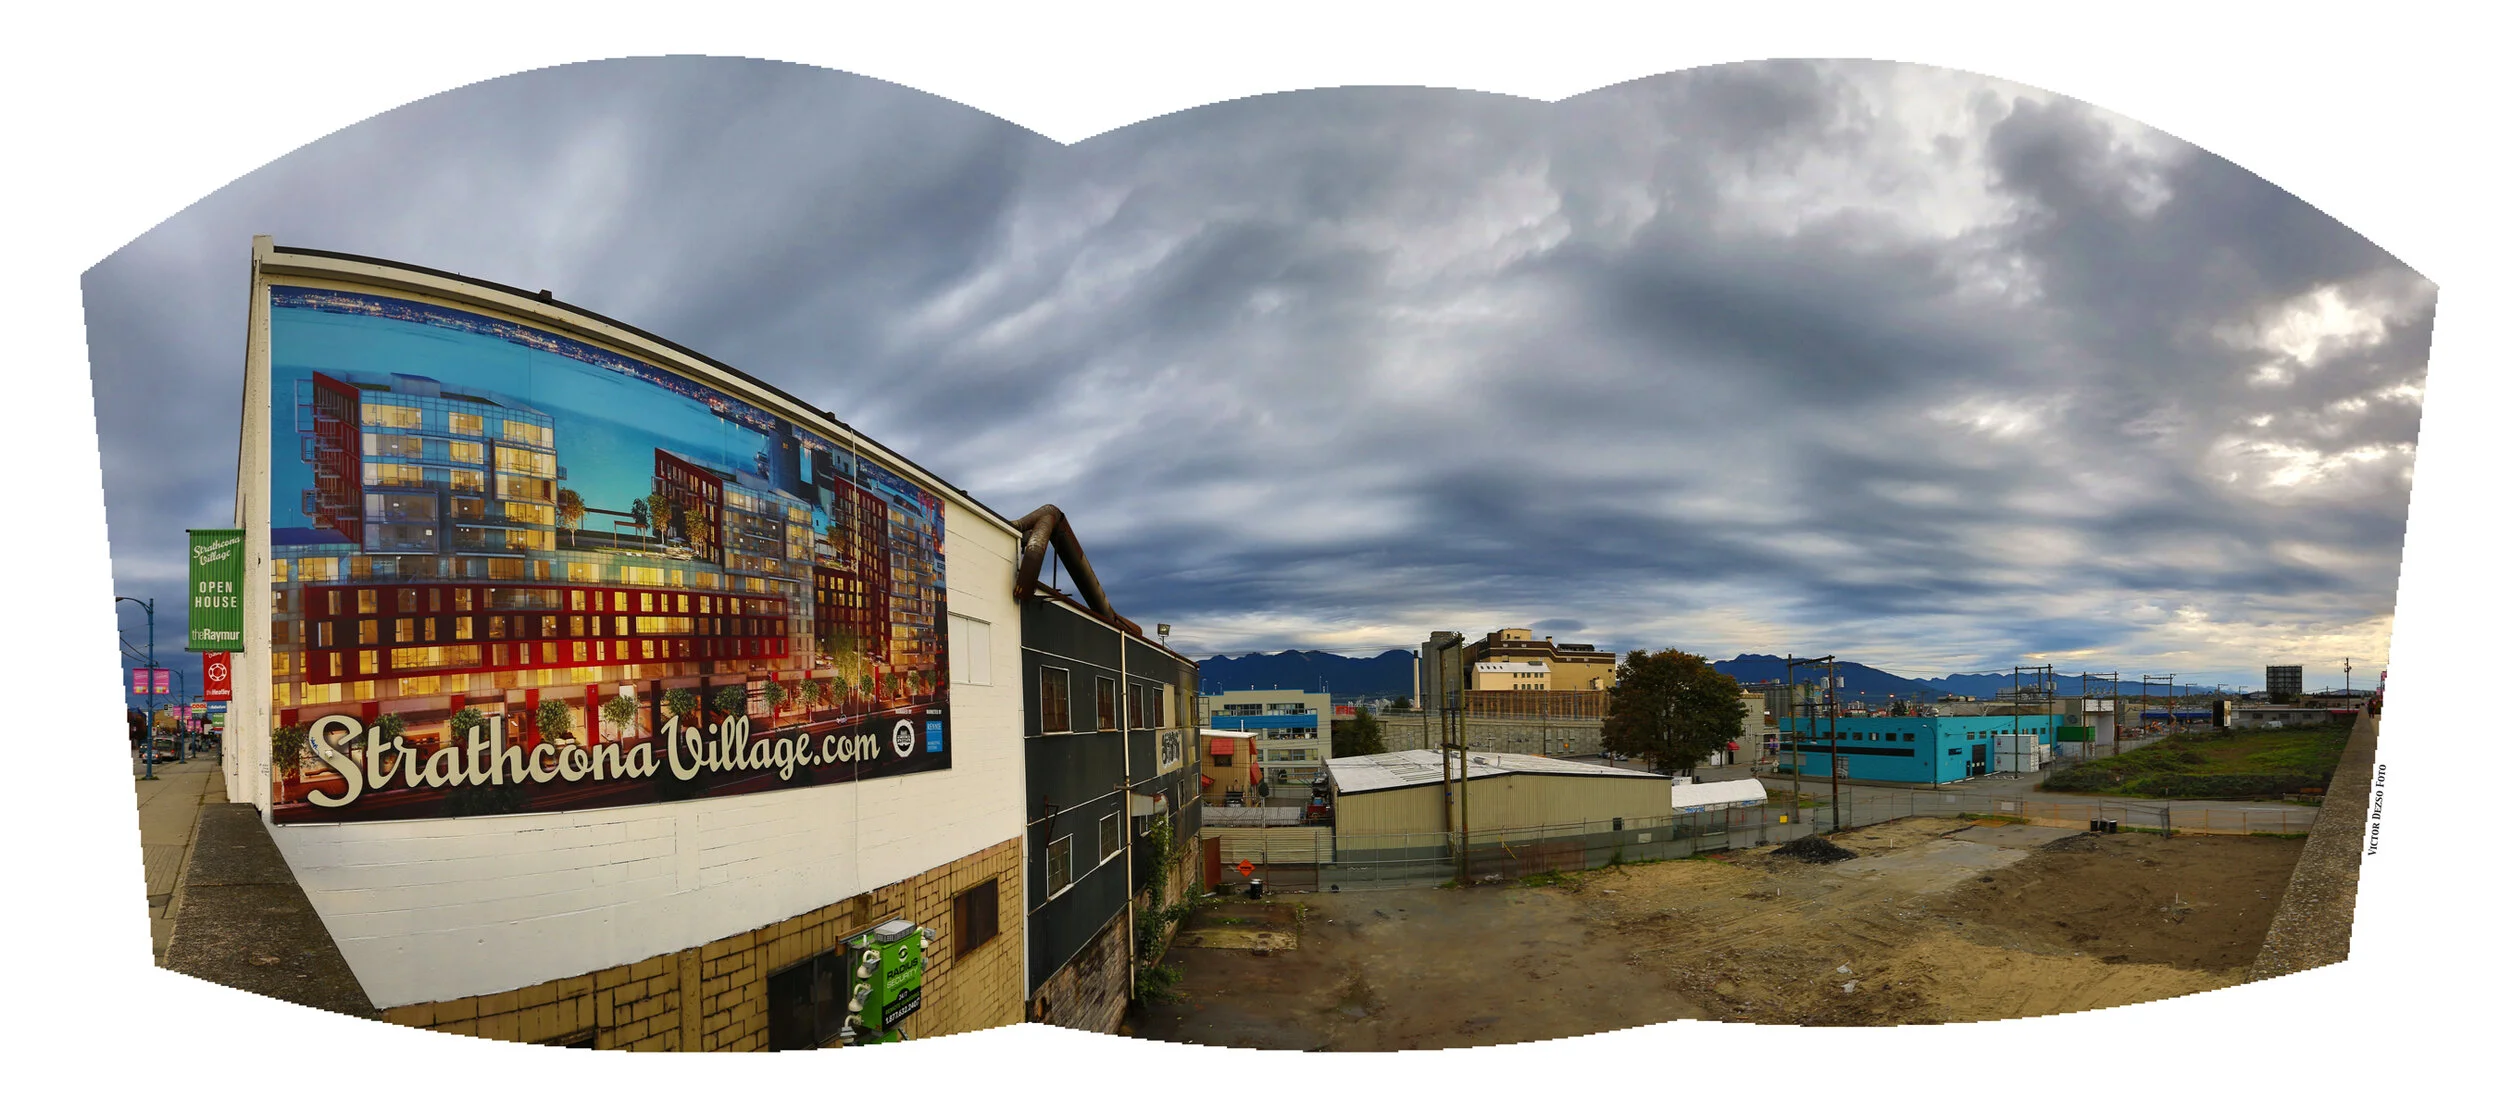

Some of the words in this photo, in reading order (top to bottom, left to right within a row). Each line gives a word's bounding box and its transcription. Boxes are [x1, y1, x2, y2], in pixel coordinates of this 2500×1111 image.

[193, 537, 240, 558] Strathcona
[200, 550, 231, 566] Village
[199, 581, 233, 593] OPEN
[195, 596, 237, 608] HOUSE
[886, 957, 918, 980] RADIUS
[886, 967, 919, 989] SECURITY
